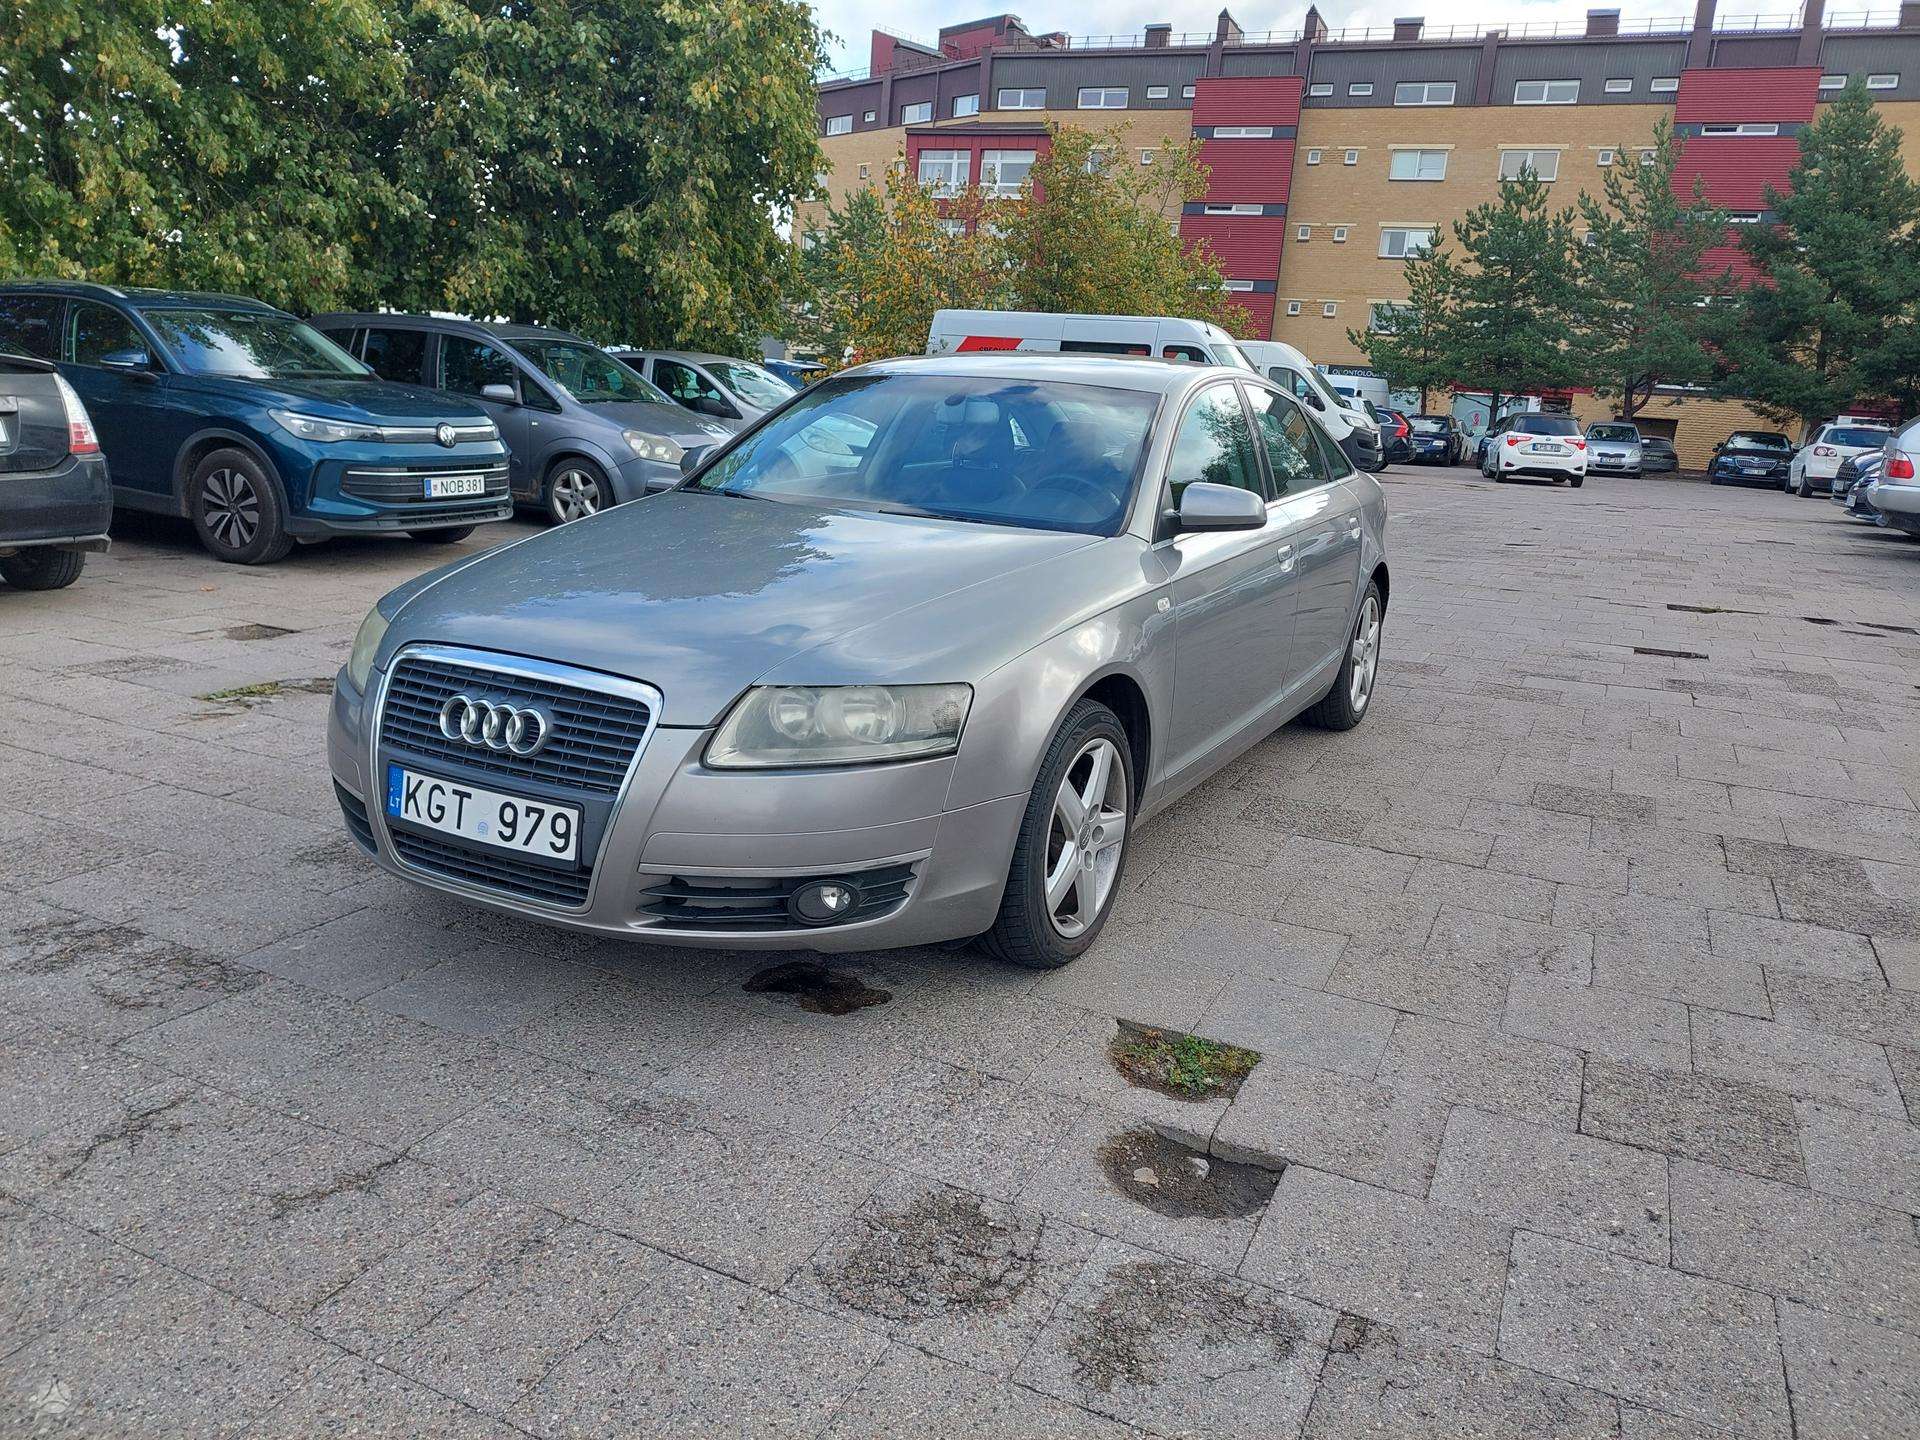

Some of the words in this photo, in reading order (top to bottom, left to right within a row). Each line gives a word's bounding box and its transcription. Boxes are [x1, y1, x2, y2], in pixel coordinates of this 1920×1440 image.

[389, 795, 401, 808] LT
[404, 775, 472, 830] KGT
[497, 801, 572, 853] 979
